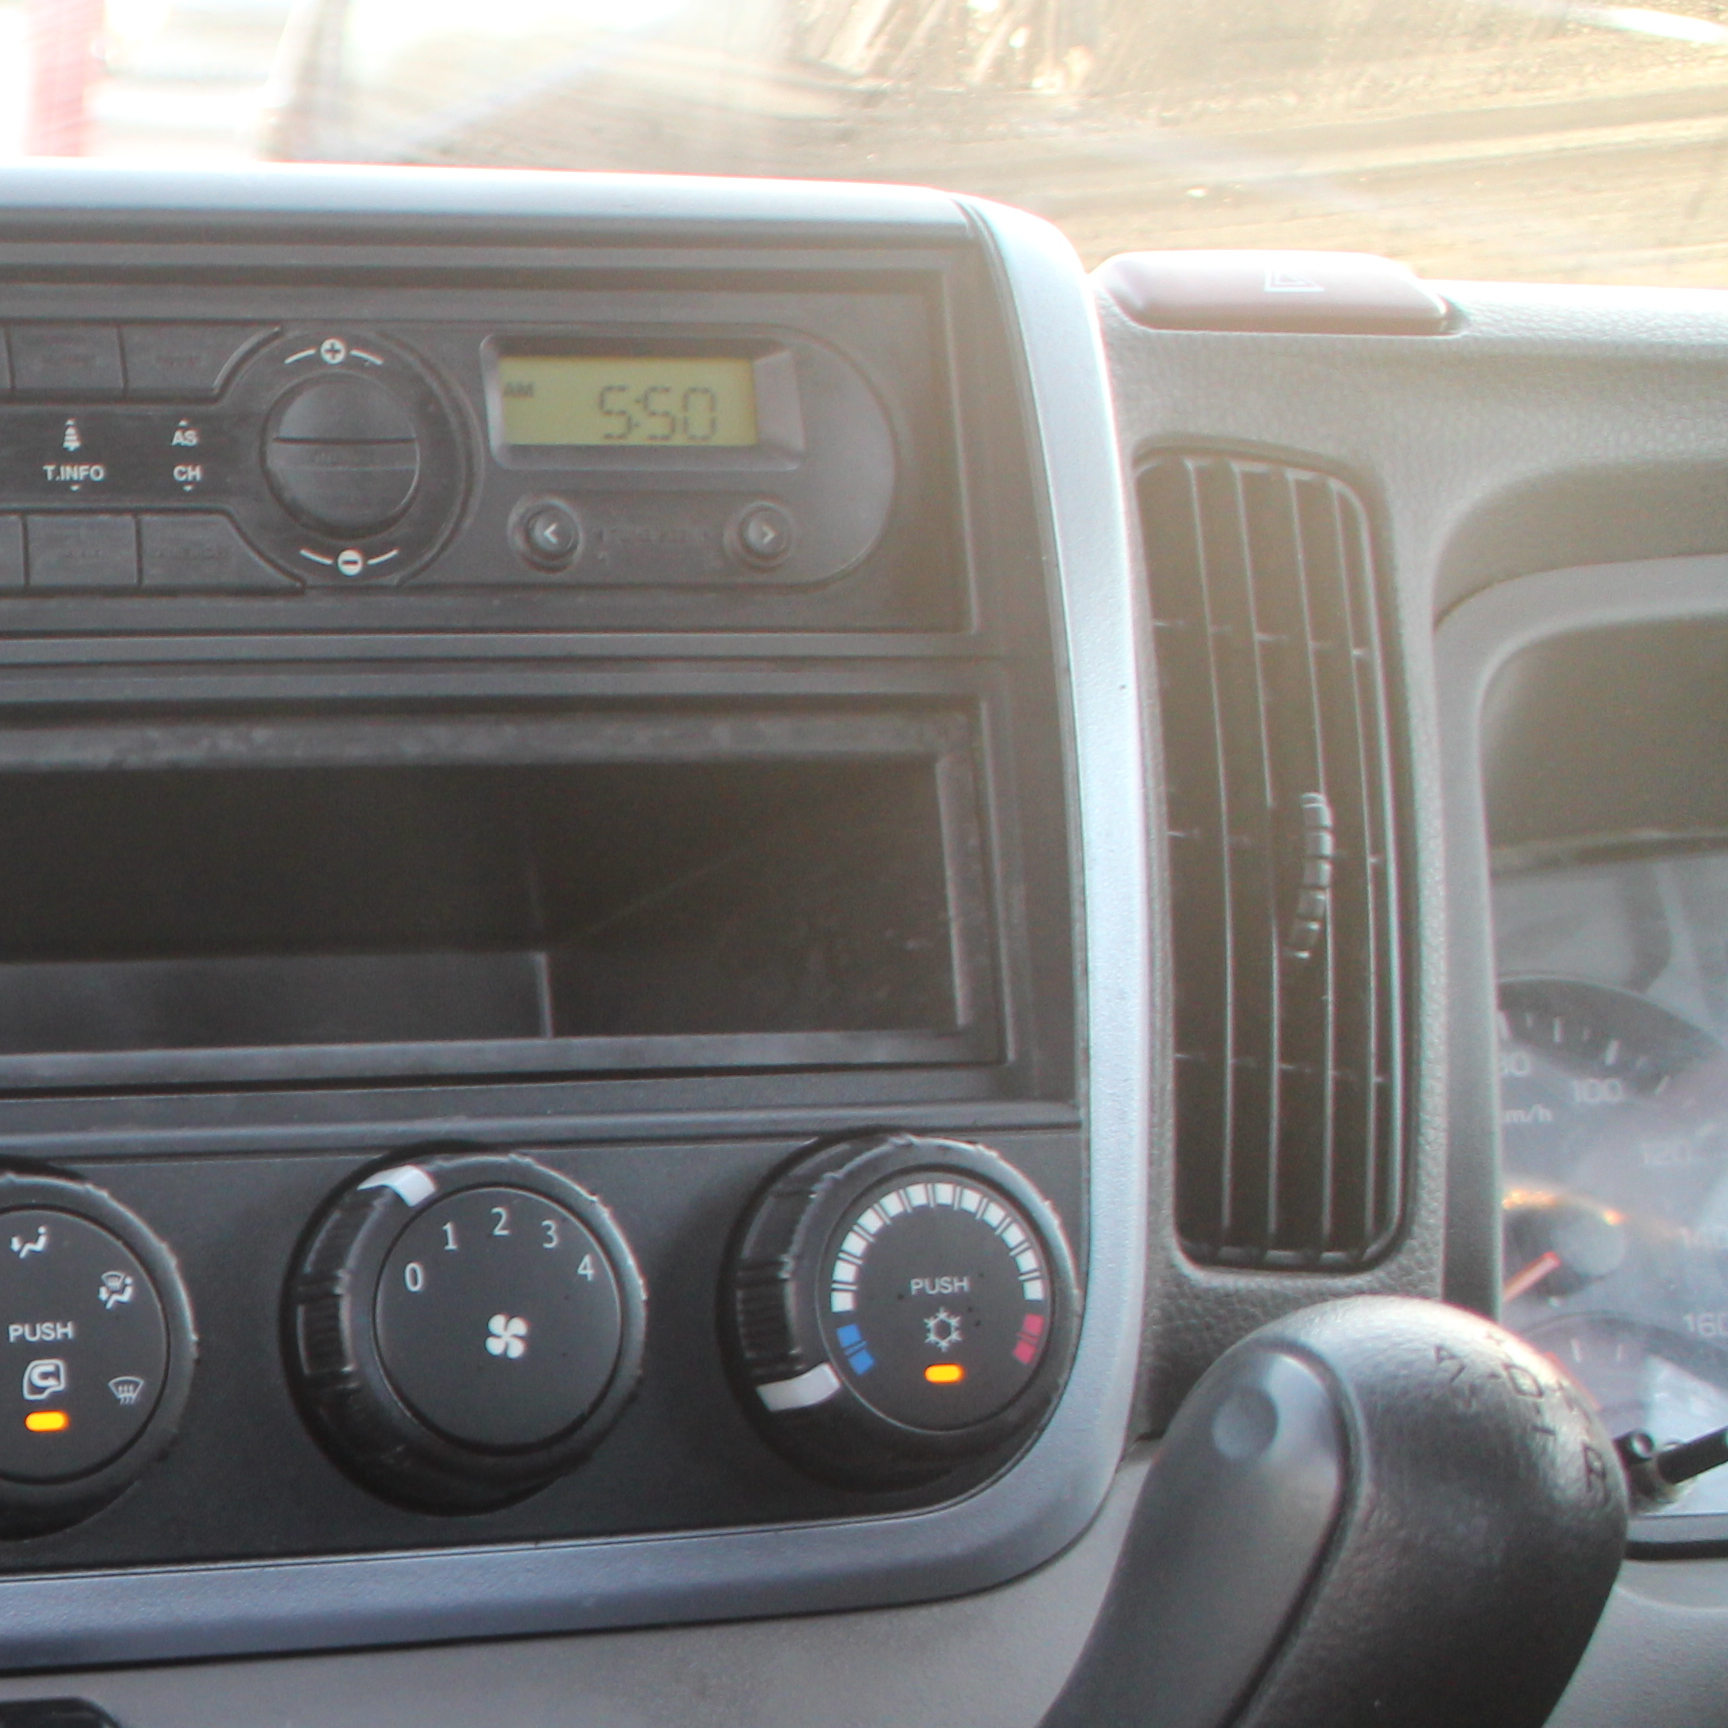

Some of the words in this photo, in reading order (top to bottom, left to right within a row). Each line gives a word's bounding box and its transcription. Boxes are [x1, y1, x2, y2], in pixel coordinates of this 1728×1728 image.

[599, 385, 716, 441] 5:50
[171, 429, 199, 446] AS
[43, 464, 105, 482] T.INFO
[173, 464, 202, 482] CH
[1571, 1077, 1624, 1104] 100
[1503, 1103, 1554, 1123] m/h
[404, 1262, 425, 1293] 0
[442, 1222, 459, 1252] 1
[490, 1206, 511, 1236] 2
[542, 1219, 561, 1249] 3
[576, 1253, 596, 1282] 4
[910, 1276, 970, 1296] PUSH
[7, 1321, 75, 1343] PUSH
